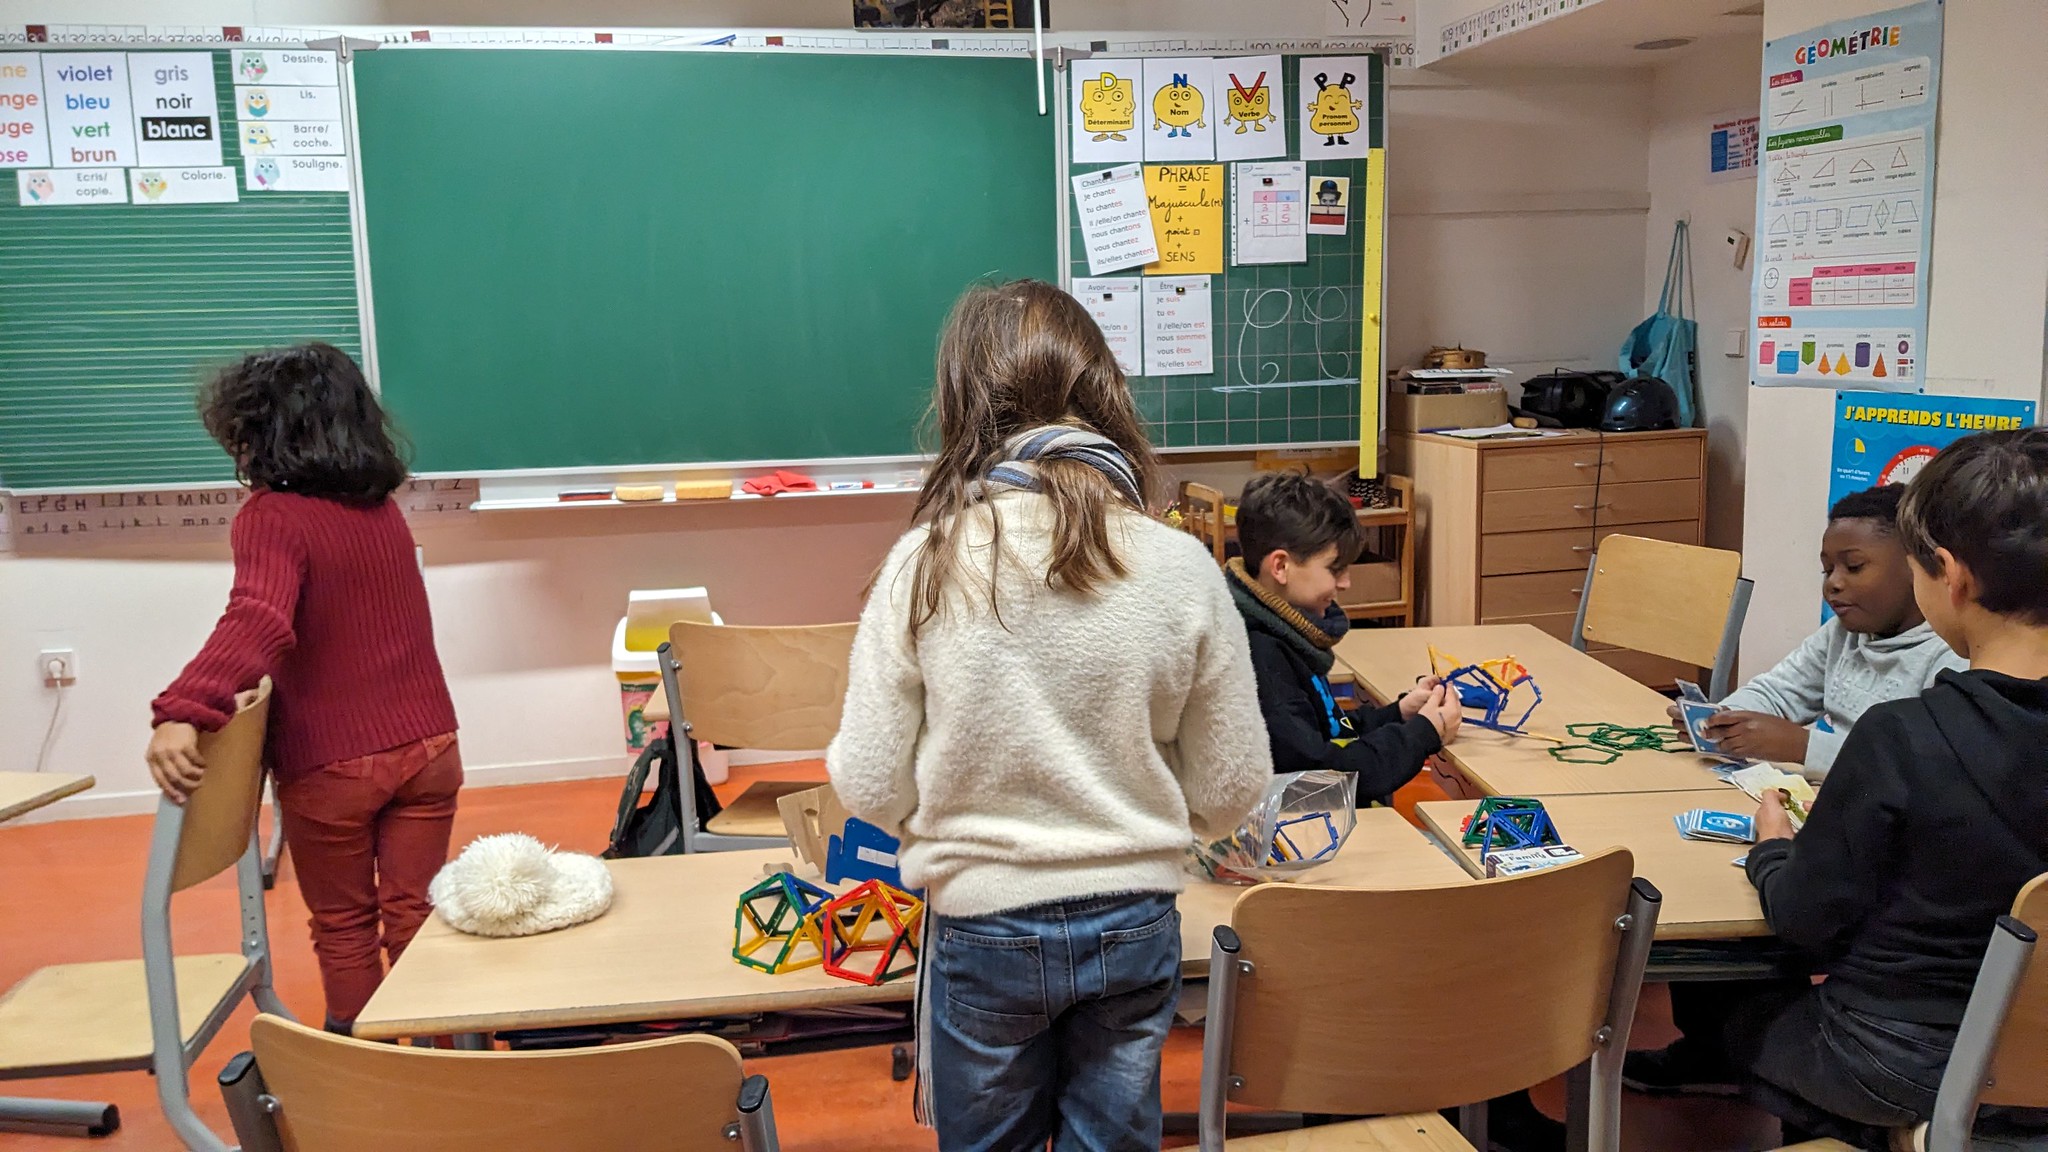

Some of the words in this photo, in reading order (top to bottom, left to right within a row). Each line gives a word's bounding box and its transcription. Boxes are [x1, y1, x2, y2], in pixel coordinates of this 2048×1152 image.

[1394, 43, 1414, 55] 106
[1794, 26, 1901, 65] GÉOMÉTRIE
[282, 53, 328, 64] Dessine.
[57, 65, 113, 81] violet
[155, 66, 189, 85] gris
[1173, 73, 1188, 88] N
[1100, 72, 1118, 91] D
[1228, 71, 1267, 103] V
[1314, 72, 1328, 92] P
[1339, 72, 1356, 89] P
[299, 89, 316, 99] Lis.
[66, 94, 110, 110] bleu
[156, 94, 192, 110] noir
[72, 122, 110, 137] vert
[147, 121, 207, 138] blanc
[293, 124, 329, 134] Barre/
[1087, 118, 1130, 126] Déterminant
[293, 137, 332, 148] coche.
[71, 147, 116, 162] brun
[292, 159, 343, 171] Souligne.
[1159, 167, 1211, 182] PHRASE
[76, 186, 113, 198] copie.
[1093, 188, 1116, 198] chante
[1096, 201, 1123, 212] chantes
[1123, 209, 1146, 220] chante
[1261, 215, 1269, 224] 5
[1282, 214, 1290, 223] 5
[1091, 230, 1108, 238] nous
[1110, 223, 1141, 235] chantons
[1165, 227, 1190, 242] point
[1094, 244, 1110, 252] vous
[1112, 237, 1139, 248] chantez
[1124, 247, 1154, 260] chantent
[1165, 251, 1195, 262] SENS
[1160, 282, 1174, 290] Être
[1163, 322, 1192, 331] /elle/on
[1157, 361, 1185, 369] ils/elles
[1844, 406, 1942, 427] J'APPRENDS
[1946, 413, 2023, 431] L'HEURE
[20, 502, 27, 513] E
[38, 501, 46, 512] F
[55, 500, 66, 511] G
[75, 499, 86, 511] H
[136, 495, 147, 506] K
[155, 494, 163, 506] L
[178, 494, 193, 507] M
[201, 493, 211, 505] N
[216, 492, 227, 504] O
